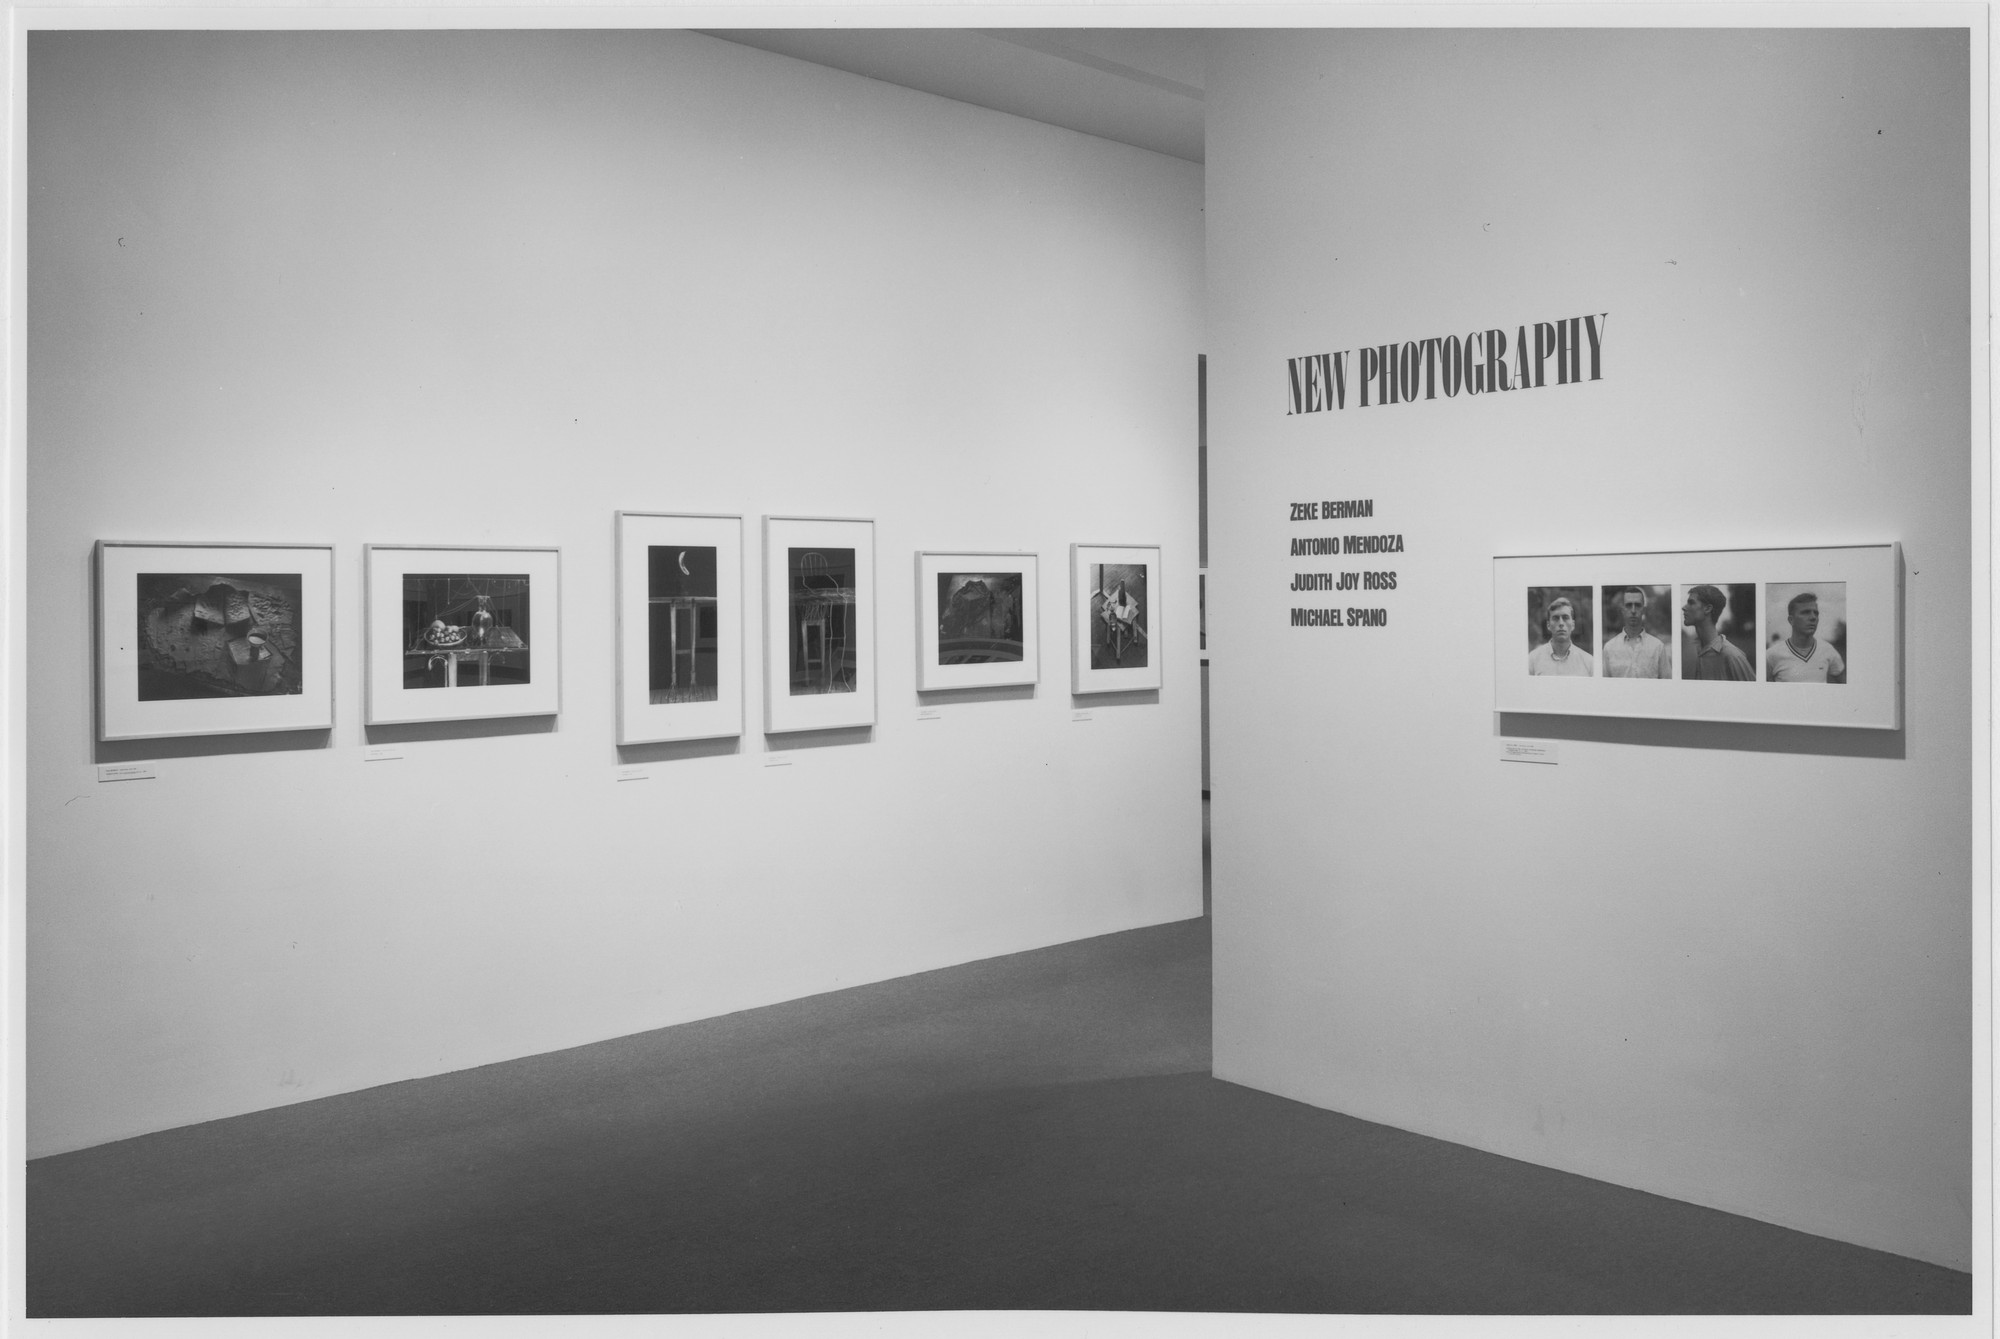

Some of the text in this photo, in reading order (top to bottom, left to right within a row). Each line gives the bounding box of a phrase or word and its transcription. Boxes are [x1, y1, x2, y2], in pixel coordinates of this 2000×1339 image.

[1286, 313, 1608, 415] NEW PHOTOGRAPHY
[1290, 499, 1373, 521] ZEKE BERMAN
[1290, 534, 1404, 556] ANTONIO MENDOZA
[1290, 571, 1397, 591] JUDITH JOY ROSS
[1290, 607, 1387, 627] MICHAEL SPANO
